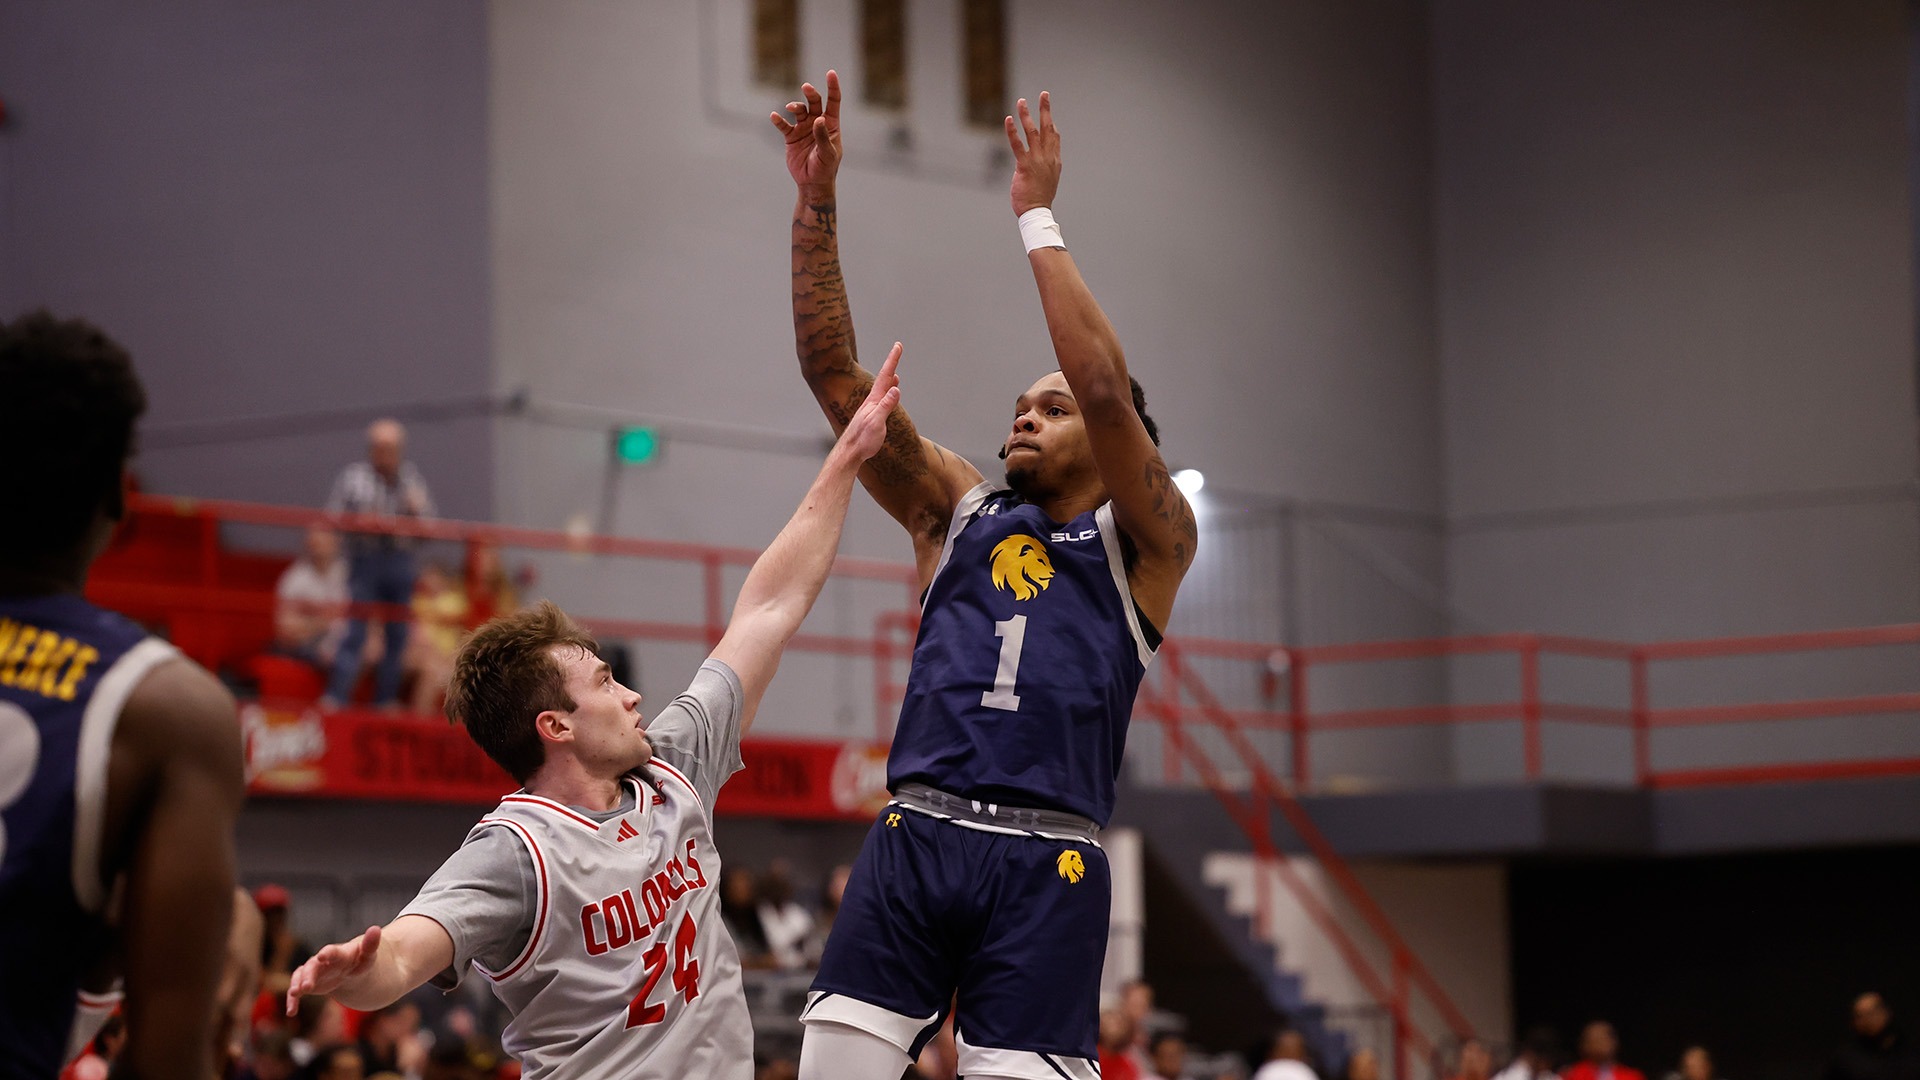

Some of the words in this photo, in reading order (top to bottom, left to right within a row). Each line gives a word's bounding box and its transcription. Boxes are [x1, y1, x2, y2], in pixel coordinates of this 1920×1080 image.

[1051, 530, 1096, 543] SLC
[980, 614, 1027, 712] 1
[623, 908, 702, 1032] 24
